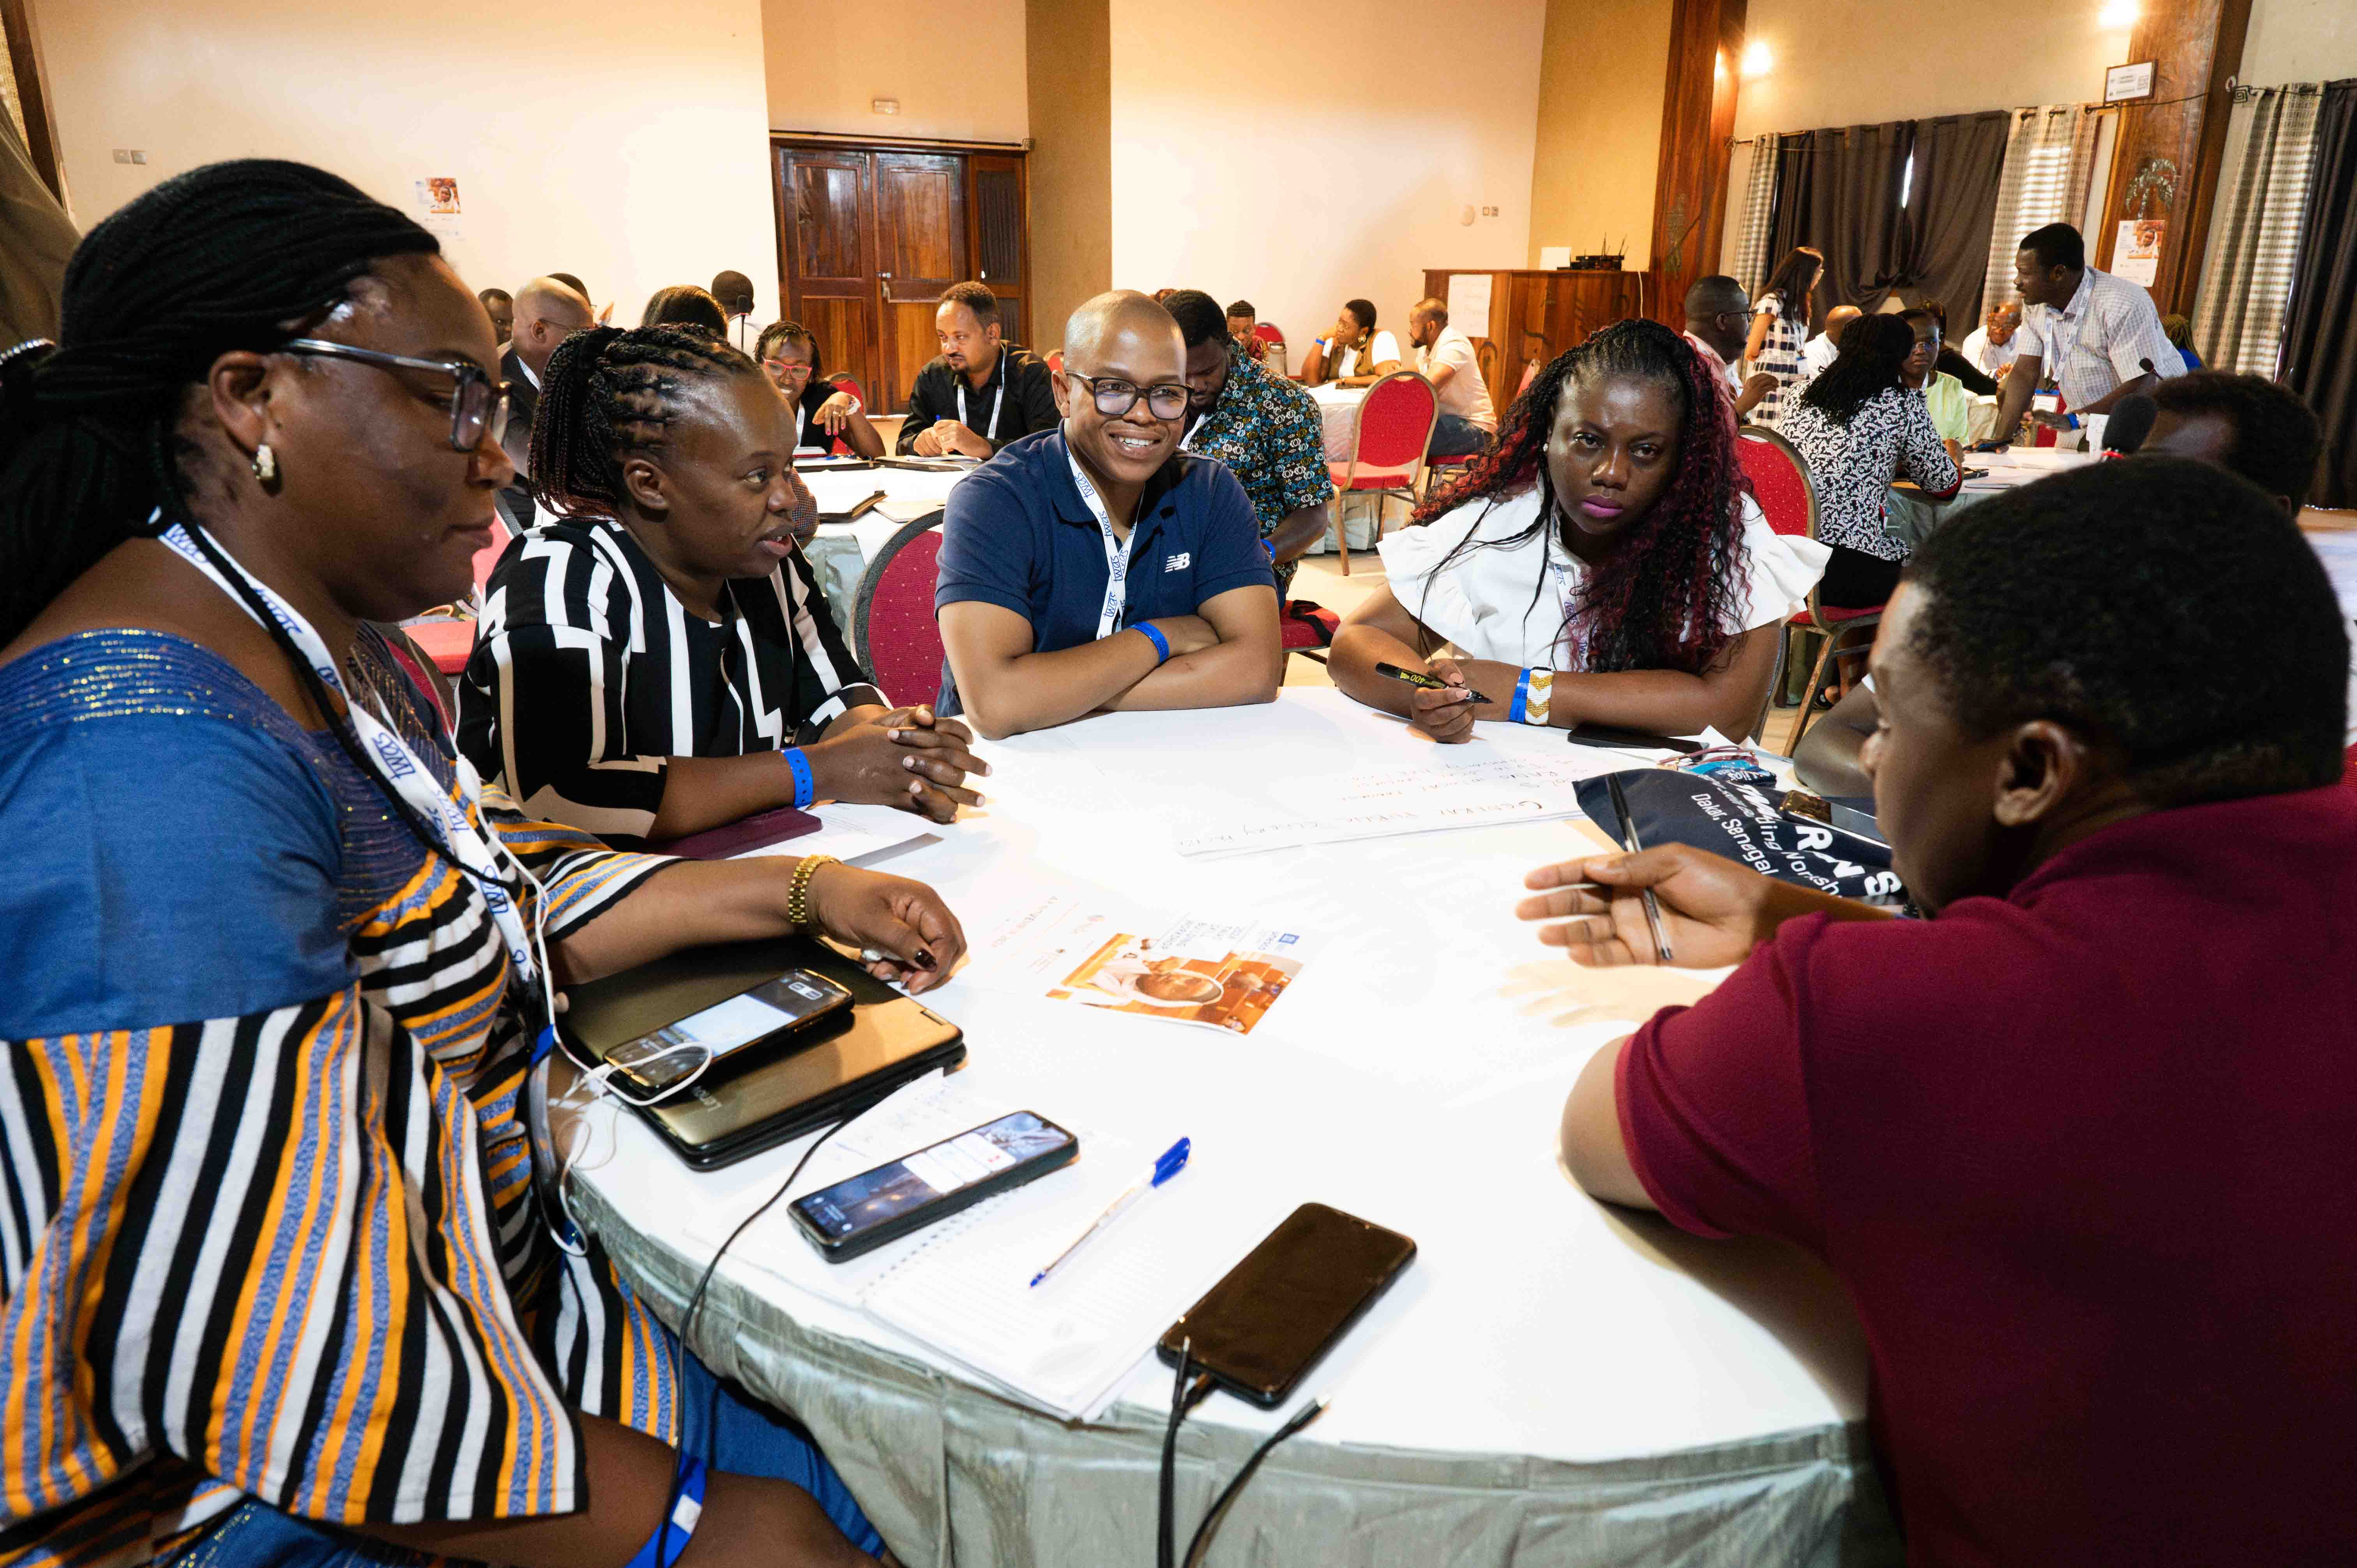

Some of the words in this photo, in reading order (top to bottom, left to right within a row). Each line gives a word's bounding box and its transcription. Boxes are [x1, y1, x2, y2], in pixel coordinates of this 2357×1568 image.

[1074, 472, 1094, 498] twas
[1098, 511, 1112, 537] twas
[1110, 555, 1123, 583] twas
[1410, 675, 1426, 683] 400
[372, 732, 415, 779] twas
[1691, 793, 1728, 821] Dakar,
[1721, 819, 1779, 875] Senegal
